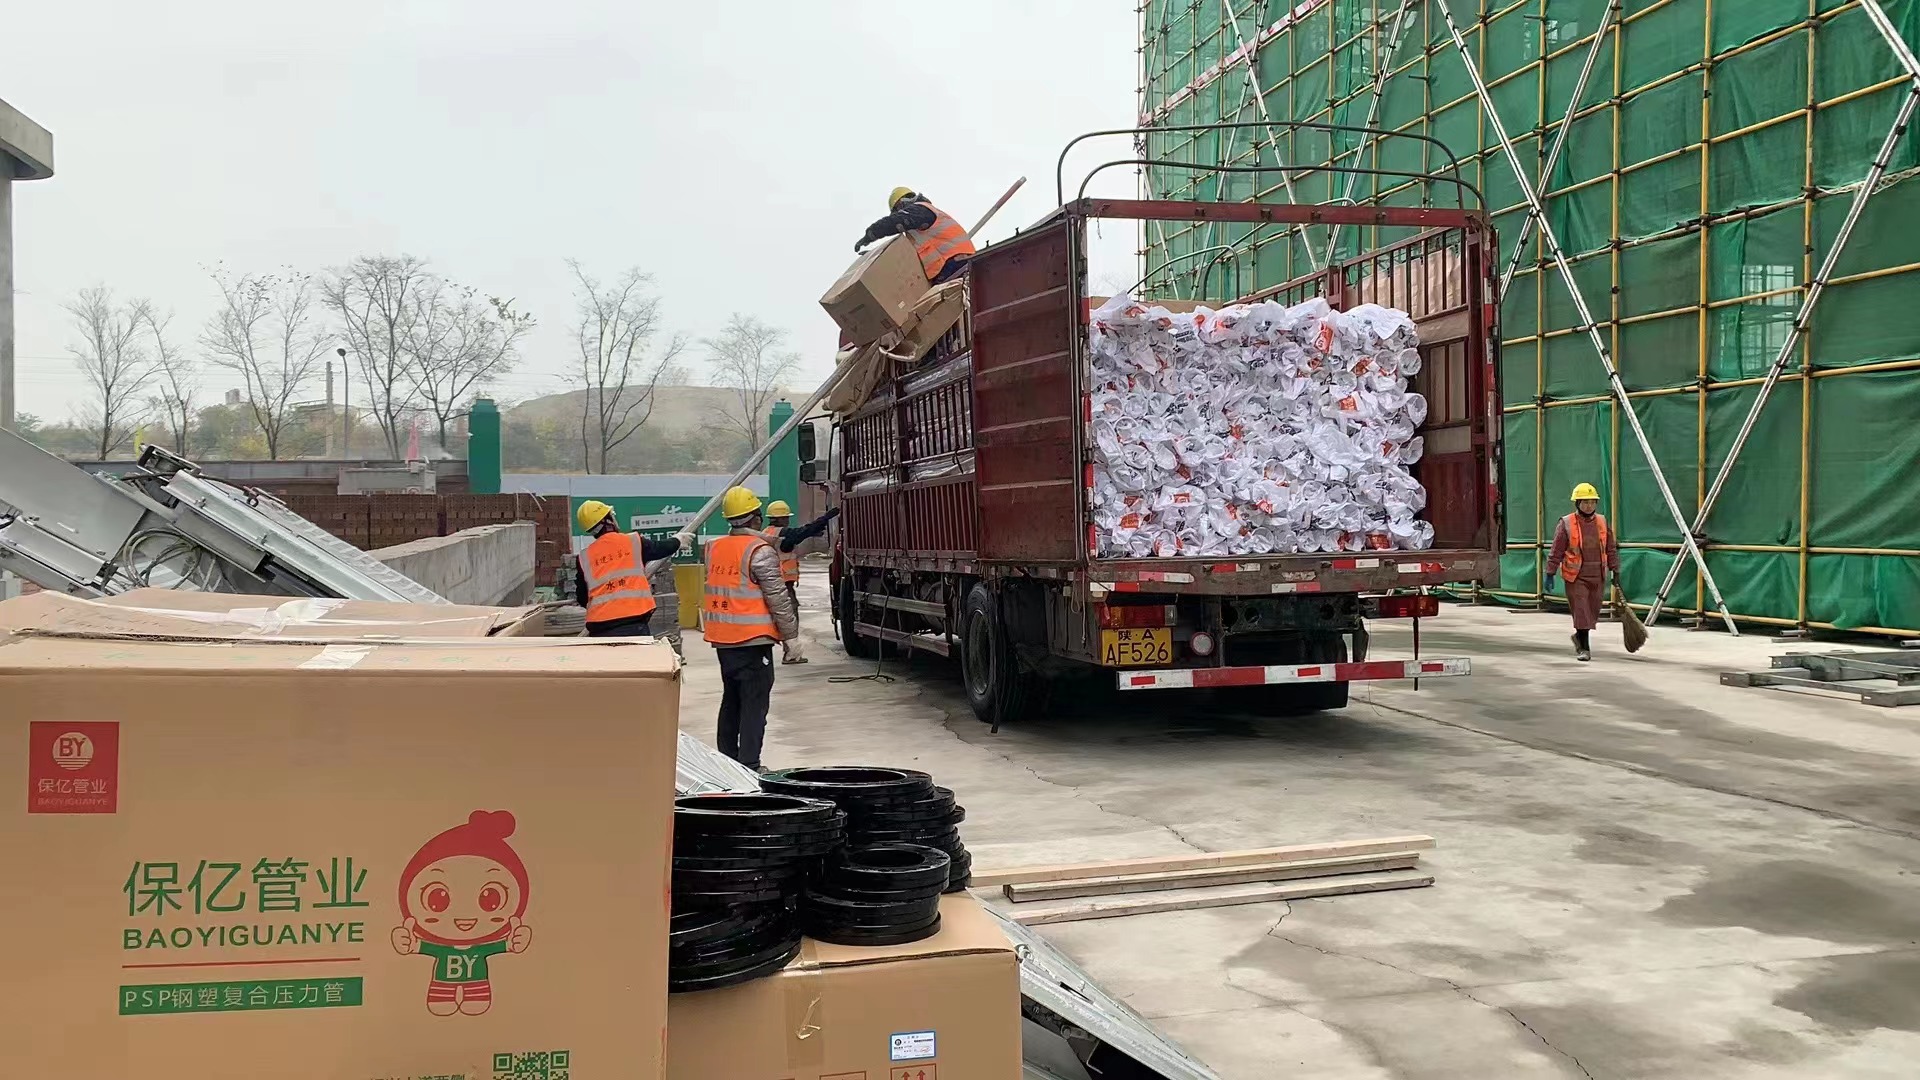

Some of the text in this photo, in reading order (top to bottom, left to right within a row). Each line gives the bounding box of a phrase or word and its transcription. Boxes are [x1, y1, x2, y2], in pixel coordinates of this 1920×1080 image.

[1105, 641, 1169, 665] AF526
[59, 737, 87, 757] BY
[37, 778, 107, 794] 保亿管业
[122, 856, 370, 917] 保亿管业
[122, 922, 365, 950] BAOYIGUANYE
[446, 953, 479, 979] BY
[124, 982, 345, 1009] PSP钢塑复合压力管
